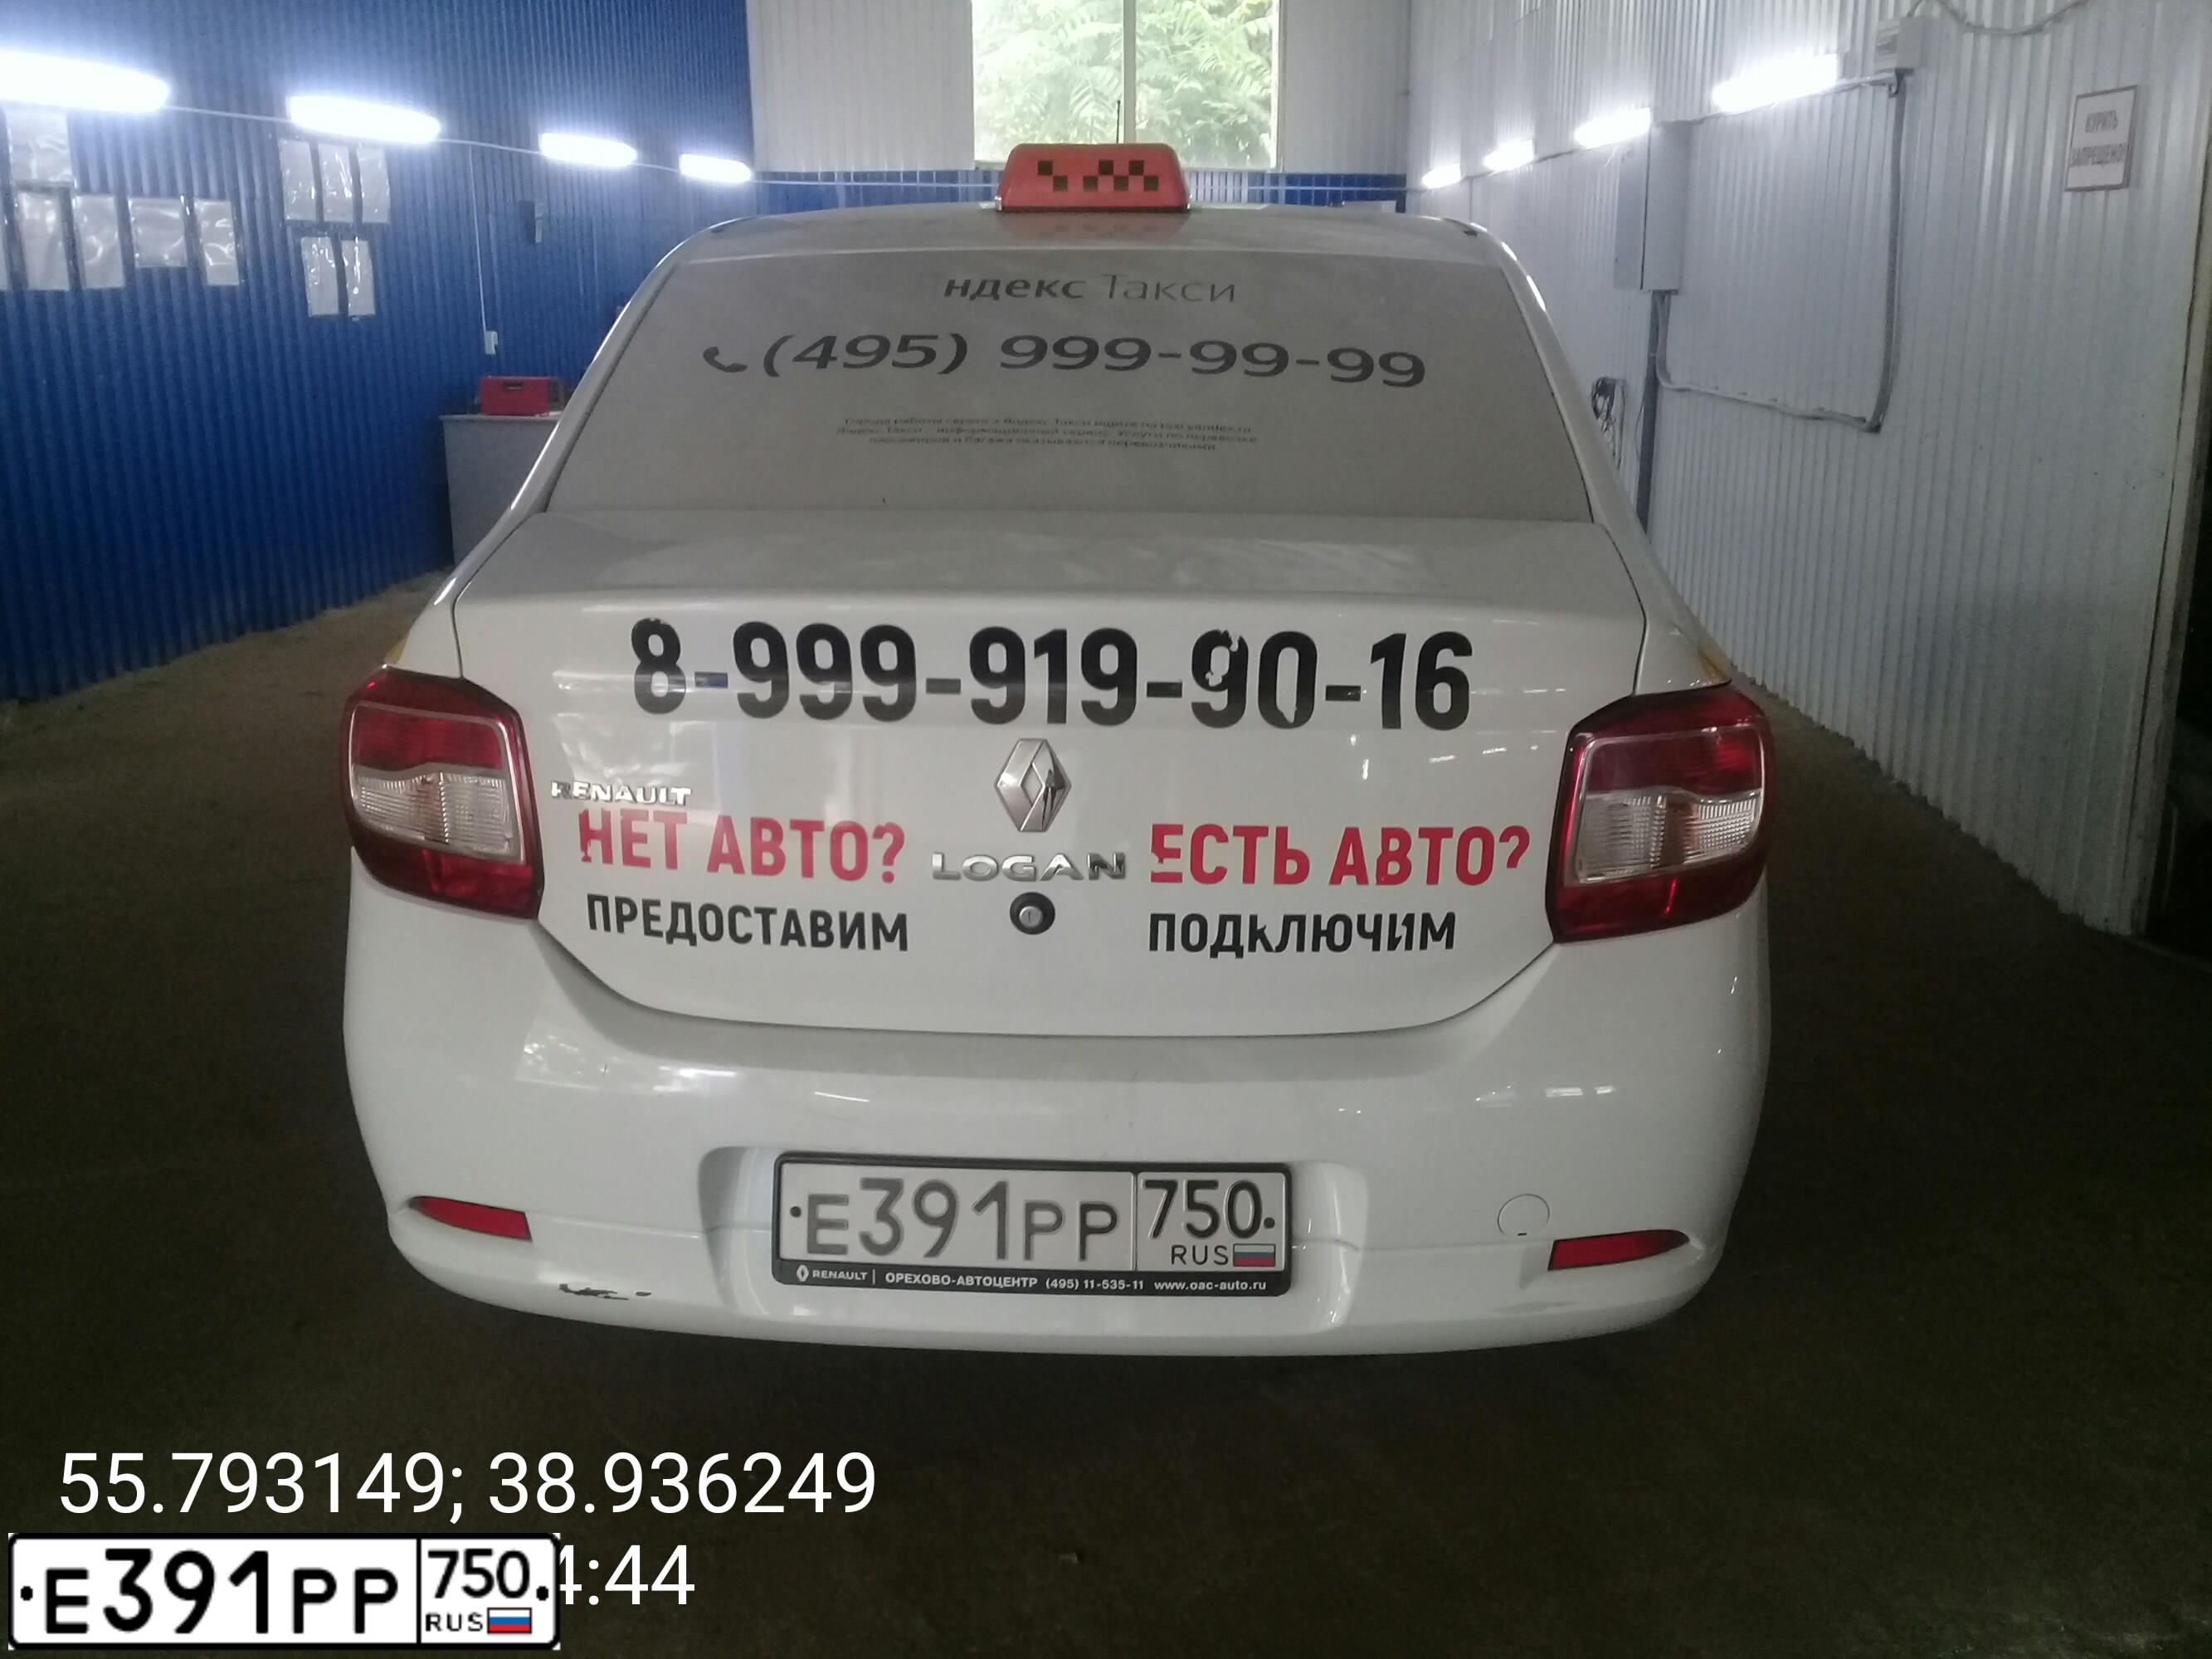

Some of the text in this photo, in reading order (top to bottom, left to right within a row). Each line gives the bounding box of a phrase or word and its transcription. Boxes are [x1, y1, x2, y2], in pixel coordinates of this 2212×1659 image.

[763, 333, 1427, 388] (495) 999-99-99
[631, 617, 1474, 731] 8-999-919-90-16
[551, 781, 691, 806] RENAULT
[578, 807, 906, 883] НЕТ АВТО?
[931, 851, 1126, 882] LOGAN
[1150, 823, 1531, 887] ЕСТЬ АВТО?
[587, 892, 909, 952] ПРЕДОСТАВИМ
[1148, 912, 1456, 960] ПОДКЛЮЧИМ
[1142, 1179, 1264, 1241] 750
[812, 1269, 868, 1282] RENAULT
[1171, 1244, 1230, 1266] RUS
[884, 1272, 1266, 1292] ОРЕХОВО-АВТОЦЕНТР (495) 11-535-11 www.oac-auto.ru
